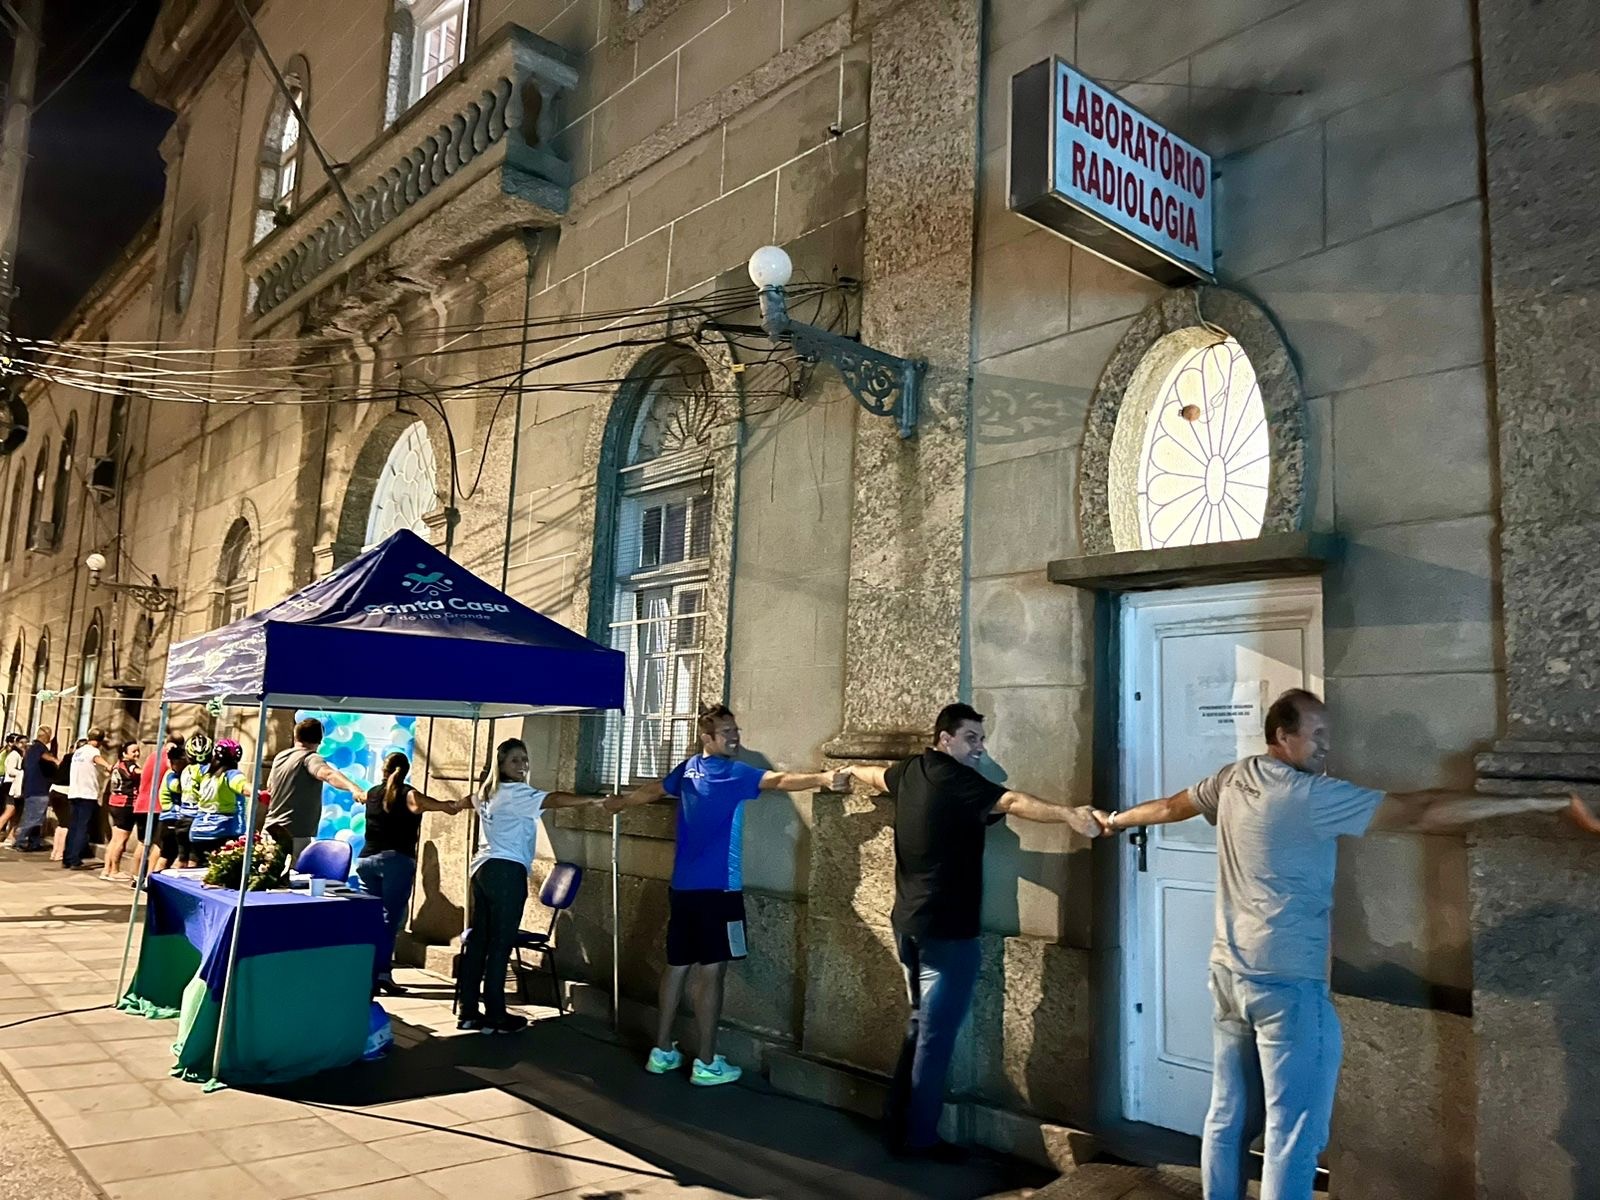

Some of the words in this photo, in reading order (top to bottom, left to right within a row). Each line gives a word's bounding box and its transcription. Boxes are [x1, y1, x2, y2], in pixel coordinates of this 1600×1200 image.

[1062, 73, 1205, 200] LABORATÓRIO
[1072, 140, 1199, 251] RADIOLOGIA
[364, 600, 445, 616] Santa
[448, 598, 510, 613] Casa
[445, 612, 491, 620] Grande
